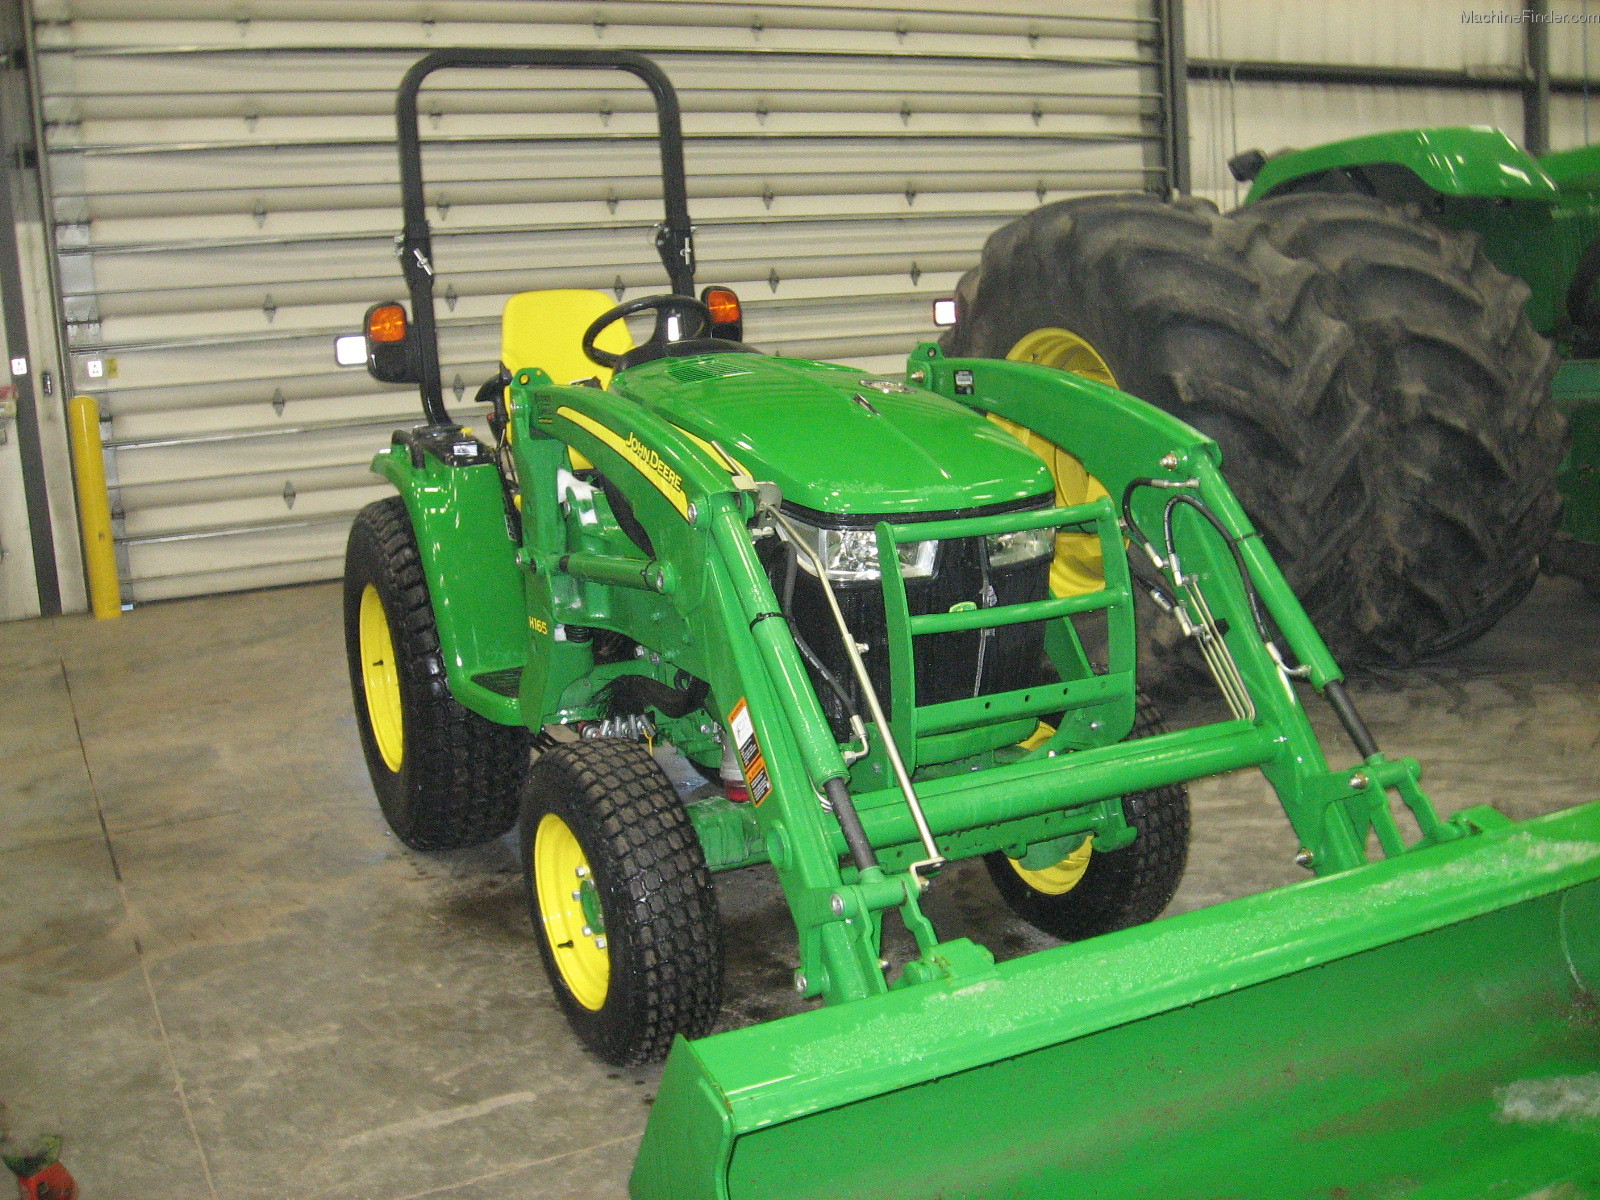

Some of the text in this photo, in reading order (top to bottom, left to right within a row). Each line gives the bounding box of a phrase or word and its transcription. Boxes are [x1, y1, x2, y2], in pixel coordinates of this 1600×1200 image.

[625, 431, 683, 492] JOHN DEERE
[528, 615, 548, 635] H165
